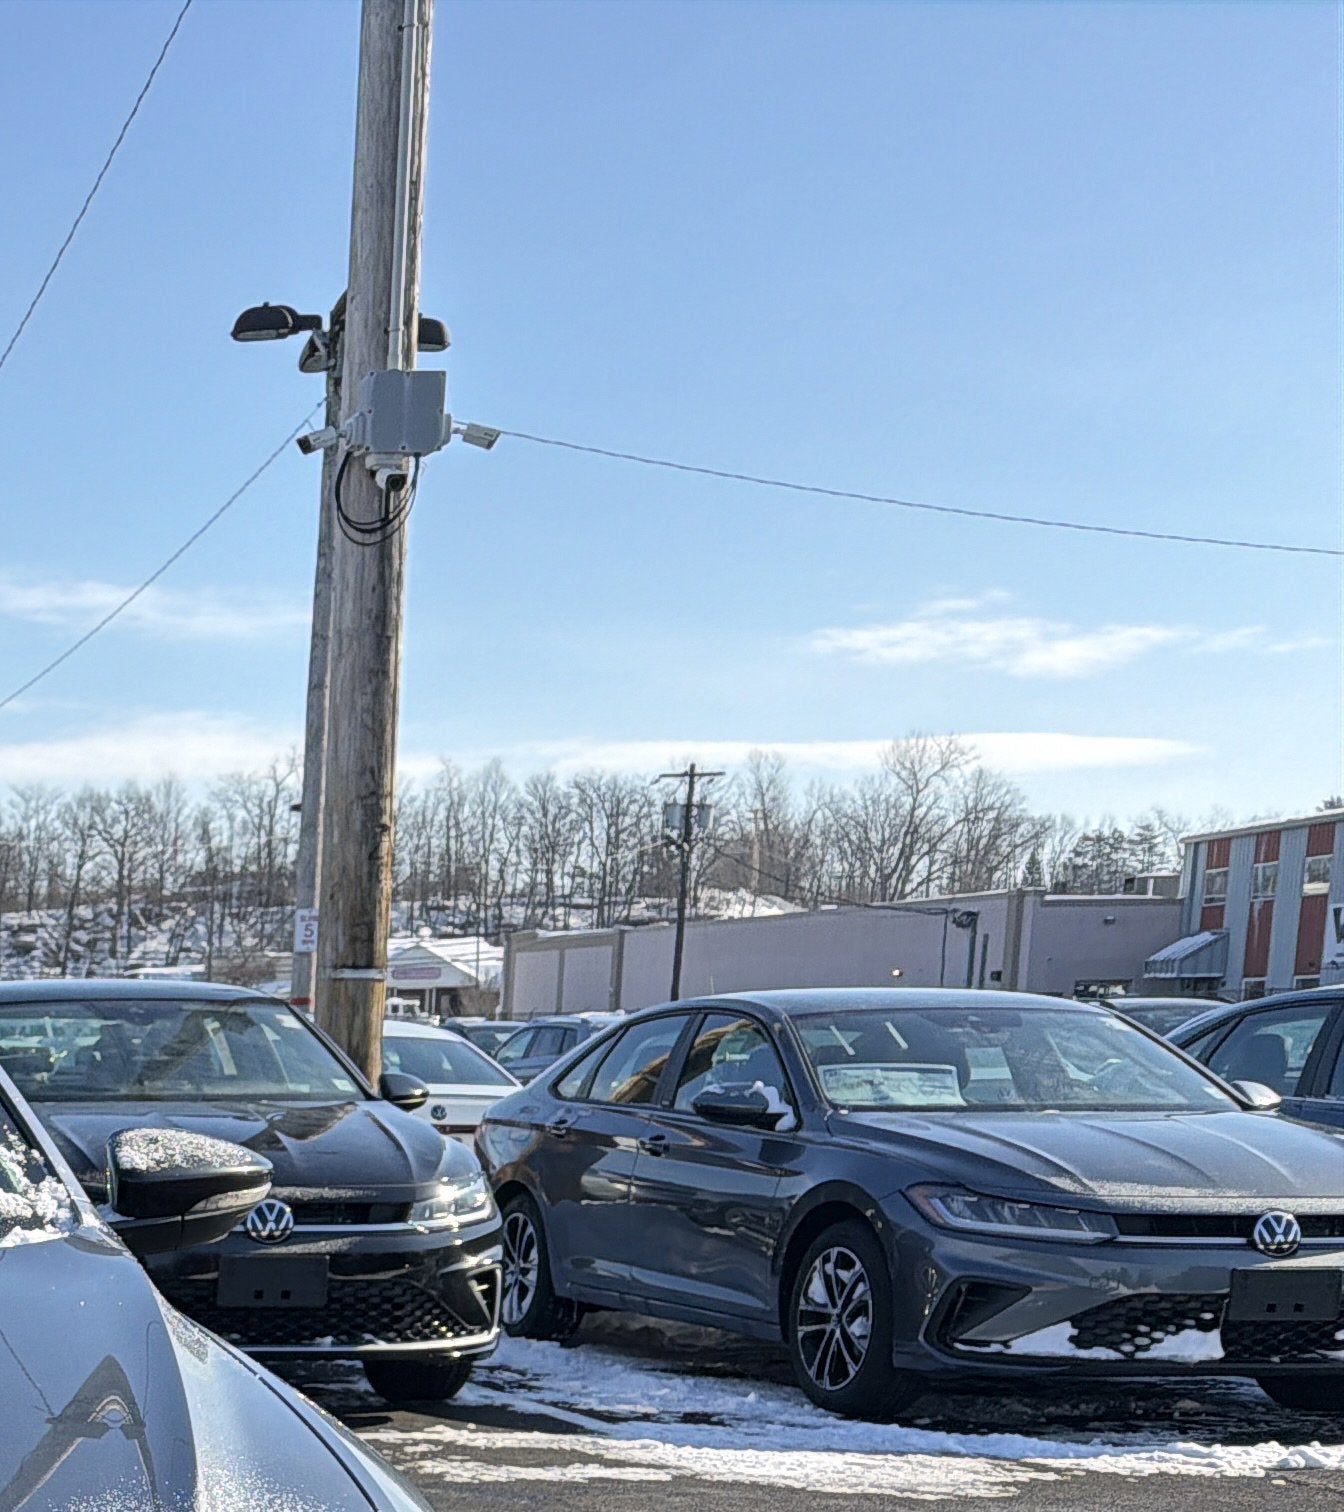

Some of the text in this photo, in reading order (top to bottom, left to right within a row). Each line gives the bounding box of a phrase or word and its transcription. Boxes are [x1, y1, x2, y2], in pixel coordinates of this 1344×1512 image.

[304, 922, 315, 938] 5
[247, 1200, 293, 1240] VW
[1254, 1211, 1301, 1254] VW
